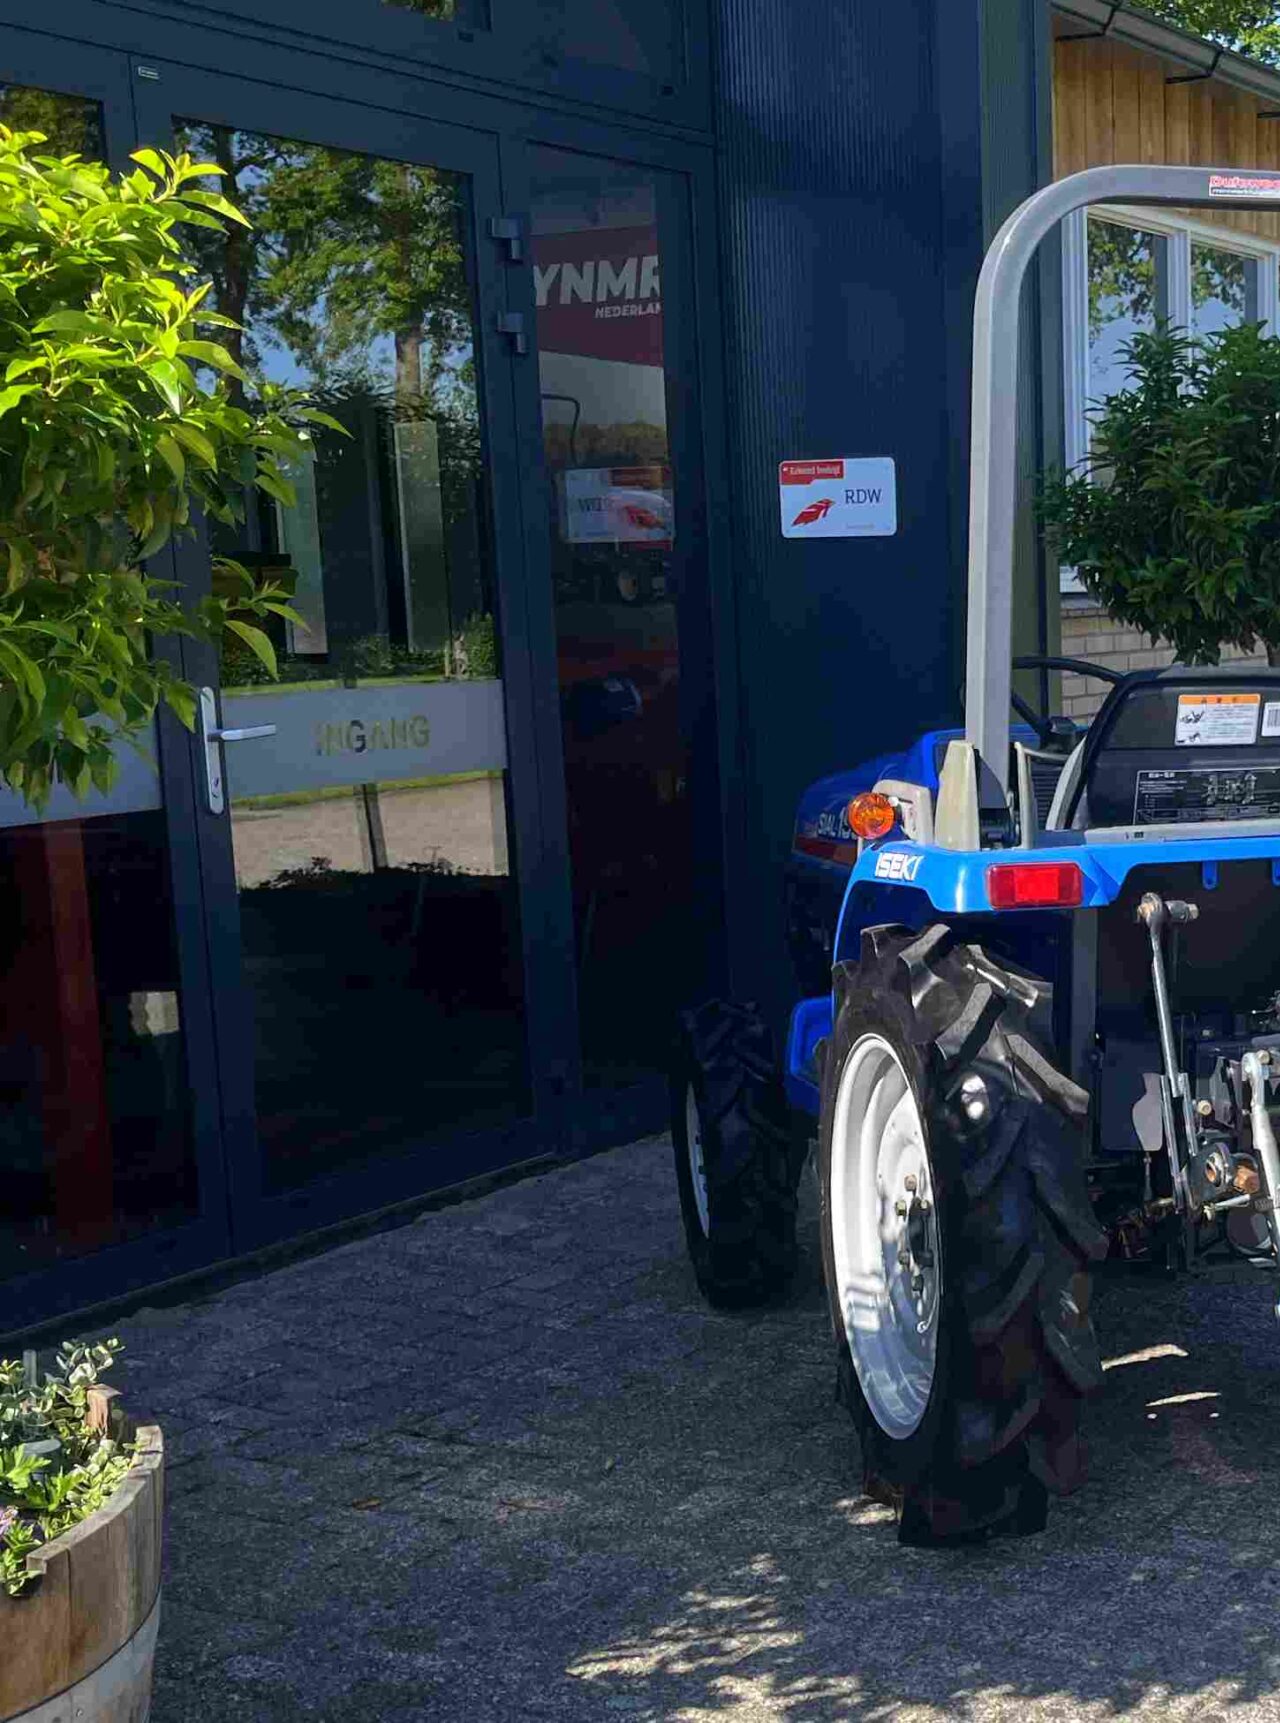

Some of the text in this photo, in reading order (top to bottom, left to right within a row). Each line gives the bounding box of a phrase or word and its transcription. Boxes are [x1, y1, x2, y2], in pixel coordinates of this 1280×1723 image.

[845, 489, 882, 504] RDW
[315, 714, 430, 756] INGANG
[875, 852, 925, 881] ISEKI
